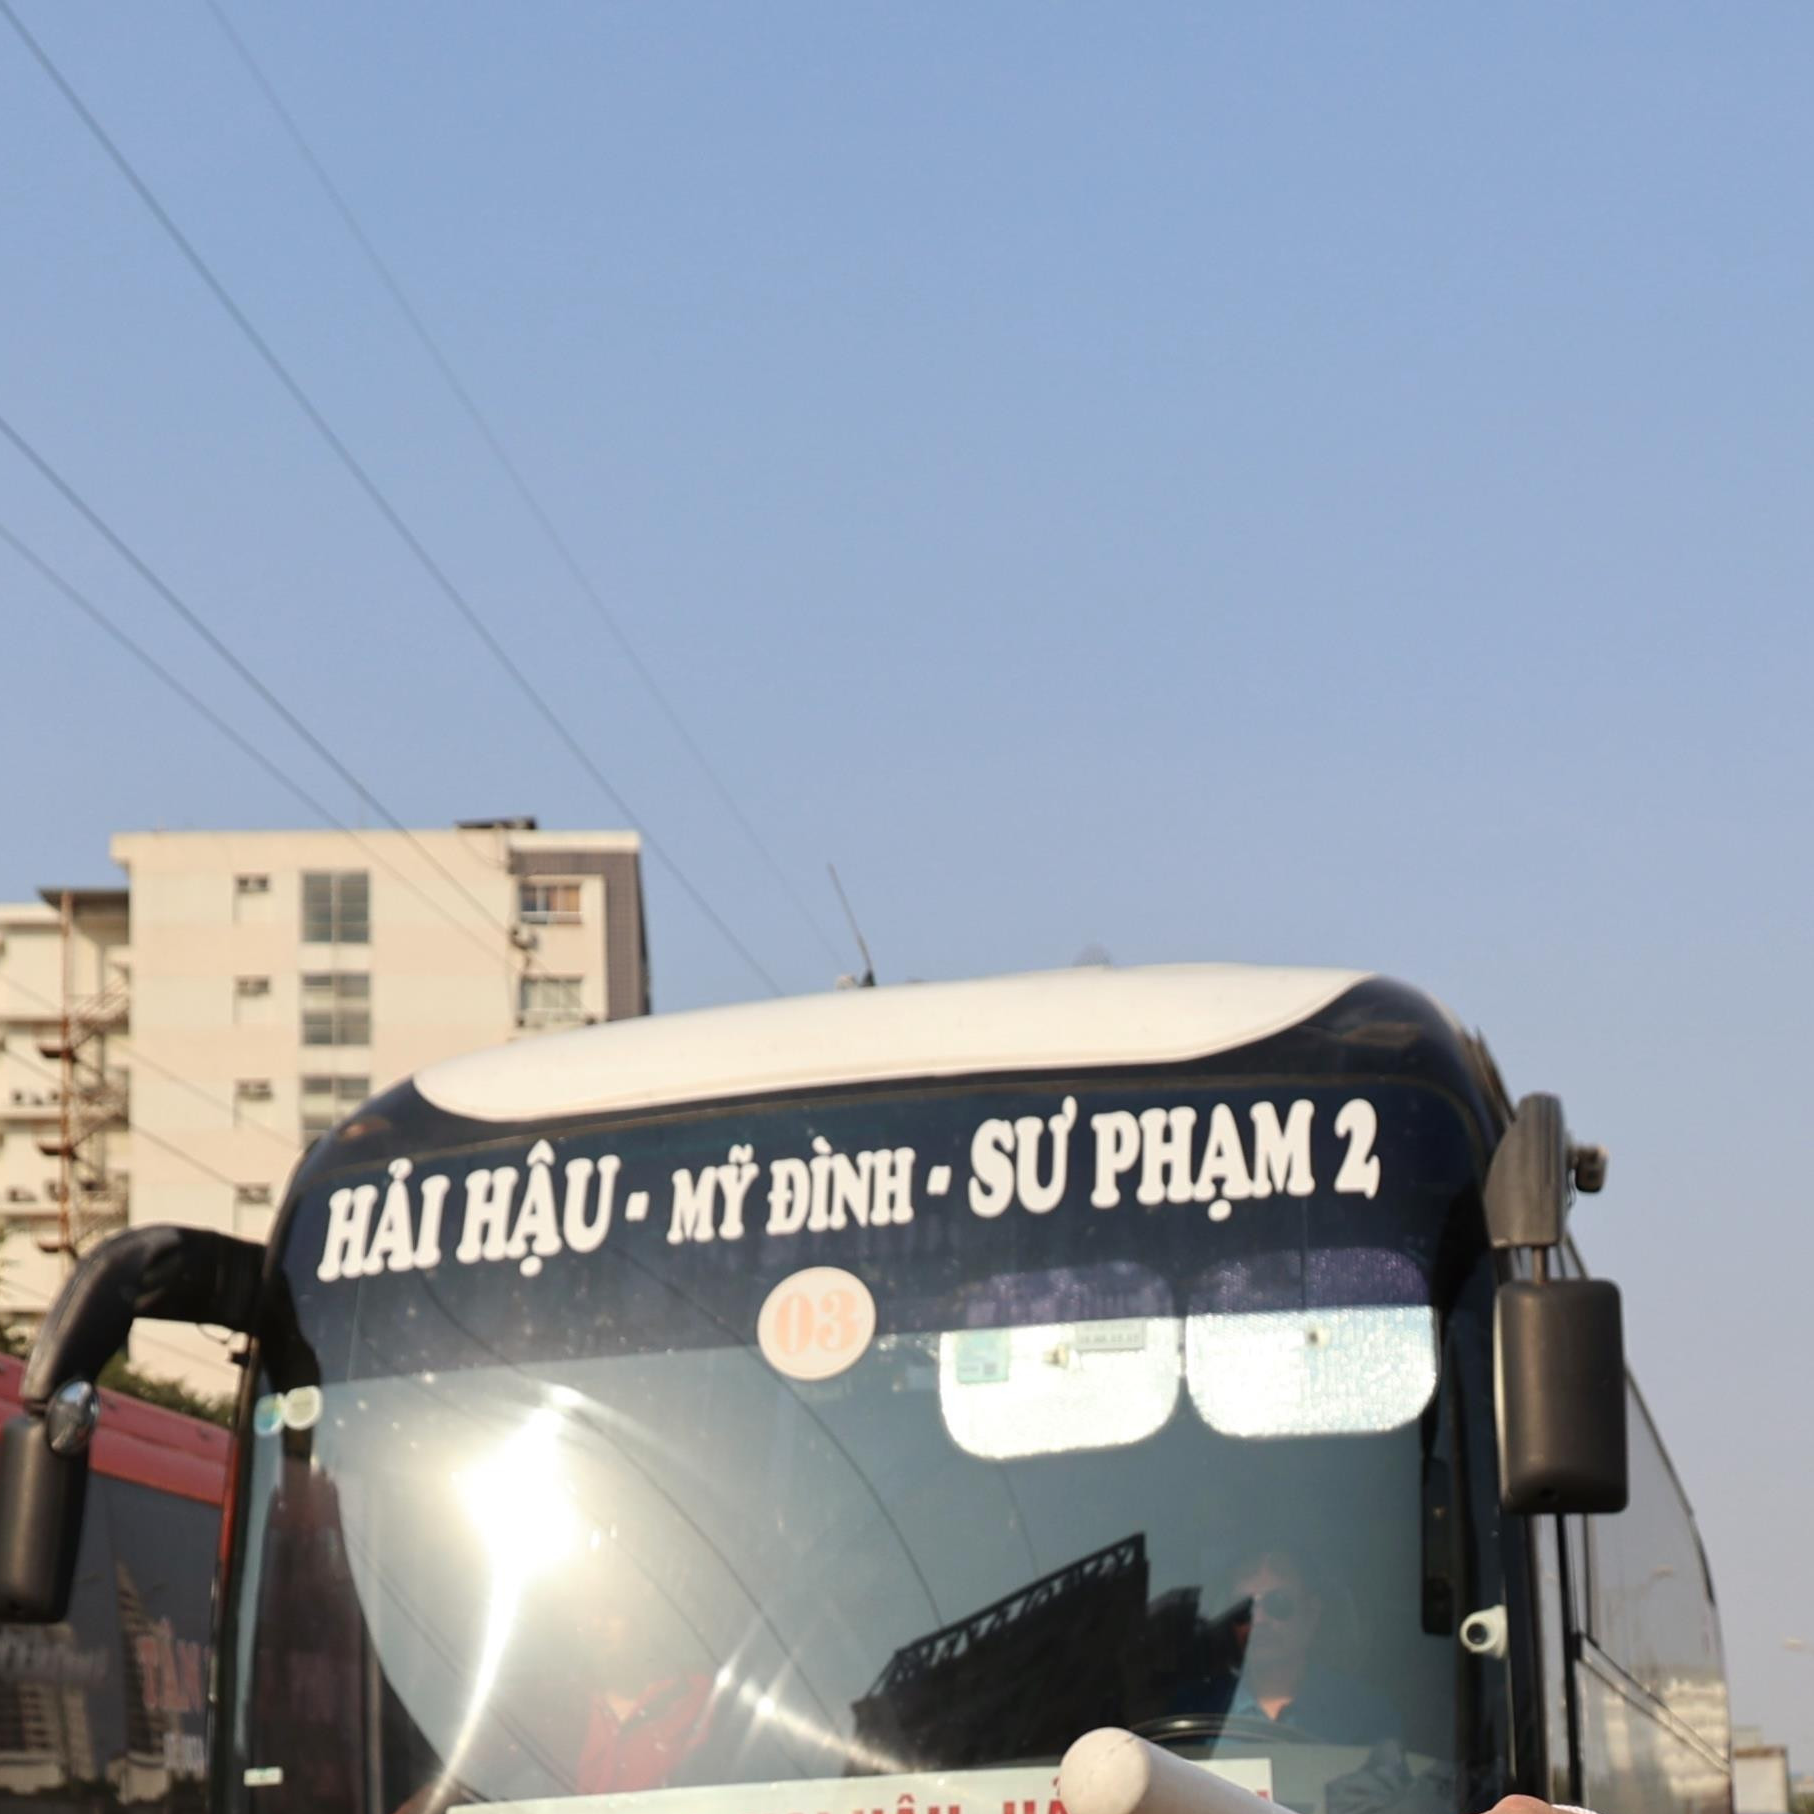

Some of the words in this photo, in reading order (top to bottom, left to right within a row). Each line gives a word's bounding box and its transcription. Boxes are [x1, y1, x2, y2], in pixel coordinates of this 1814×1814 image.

[318, 1157, 450, 1281] HẢI
[456, 1138, 620, 1277] HẬU
[667, 1143, 758, 1244] MỸ
[766, 1135, 916, 1235] ĐÌNH
[969, 1096, 1078, 1217] SƯ
[1091, 1099, 1315, 1221] PHẠM
[1334, 1098, 1381, 1199] 2
[774, 1289, 858, 1355] 03
